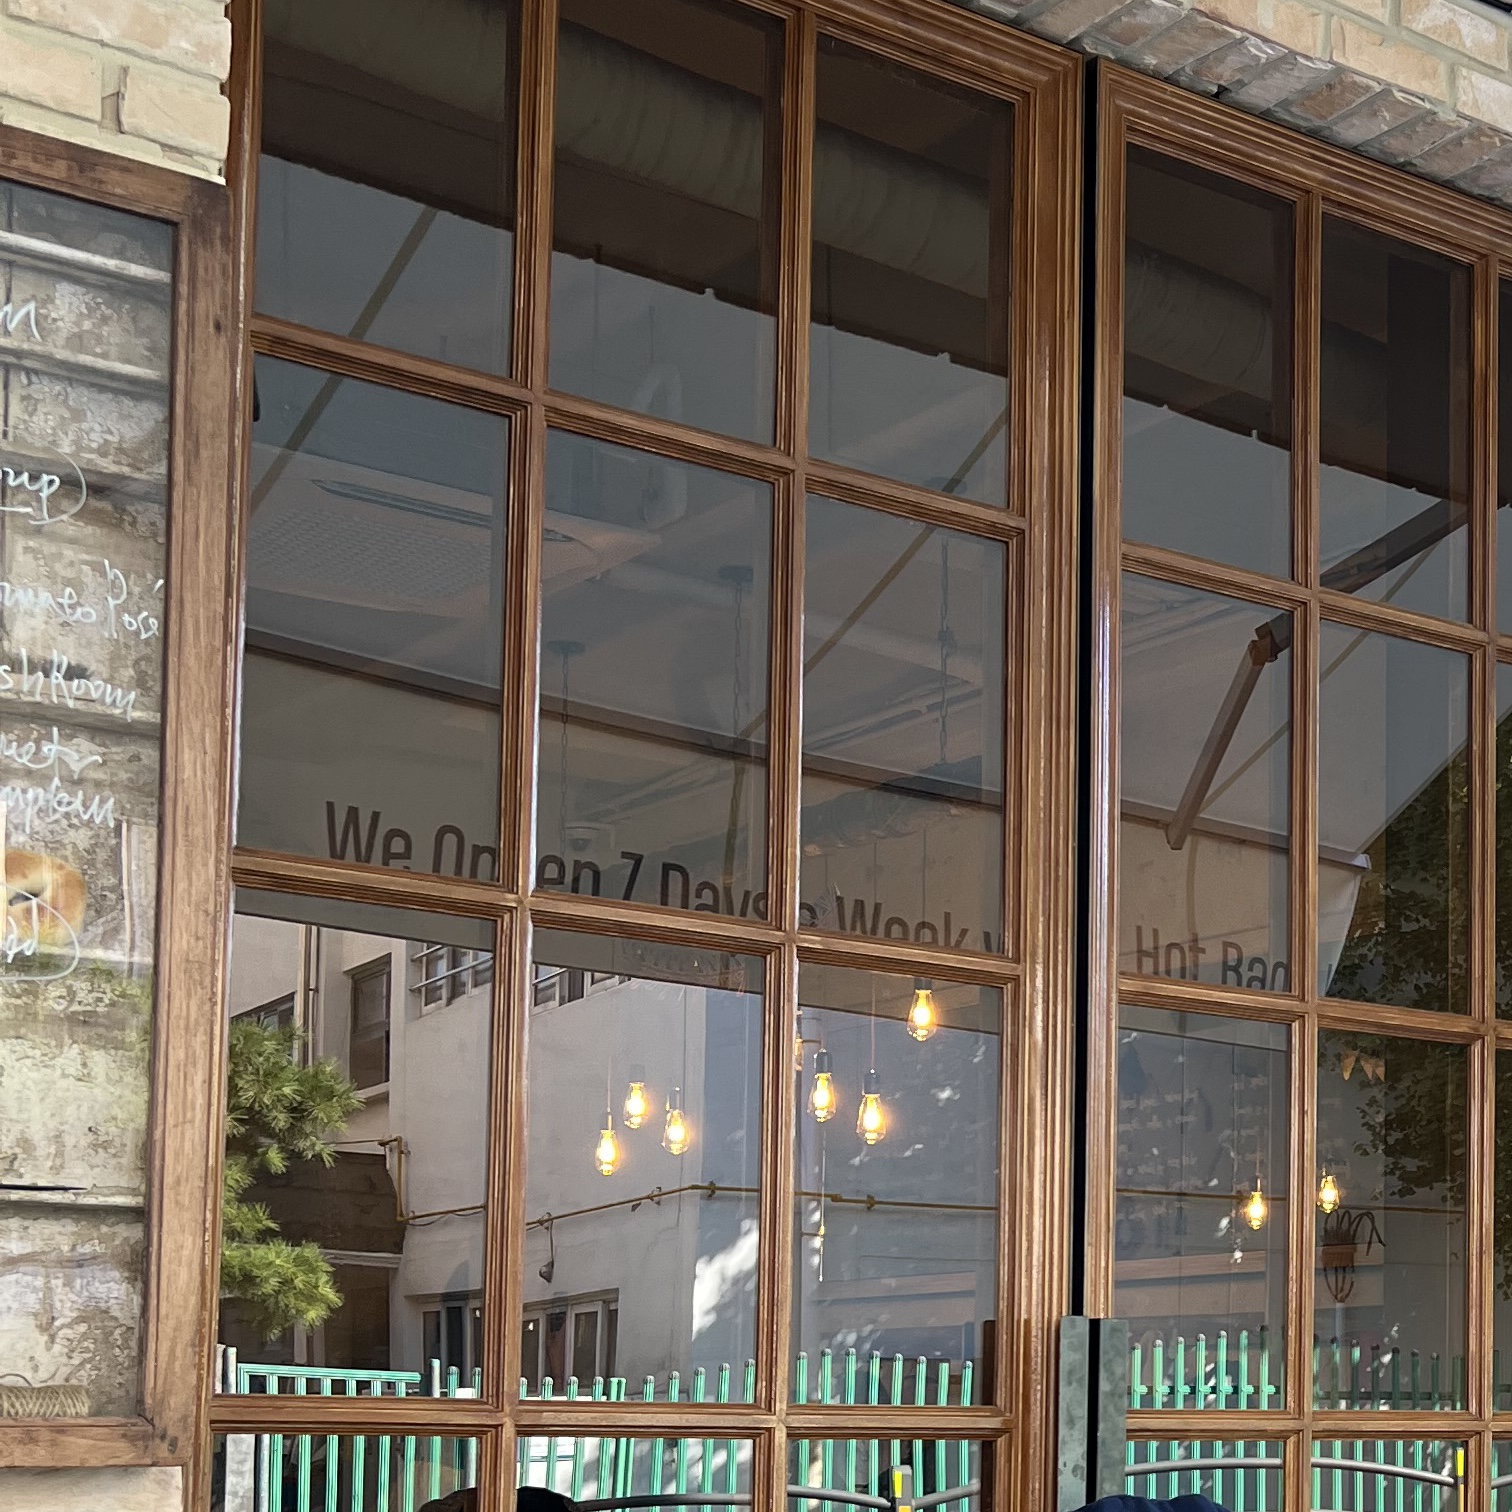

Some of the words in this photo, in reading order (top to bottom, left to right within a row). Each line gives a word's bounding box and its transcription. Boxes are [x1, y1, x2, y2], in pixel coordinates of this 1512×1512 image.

[326, 800, 412, 871] We
[610, 851, 644, 900] 7
[1136, 924, 1206, 981] Hot
